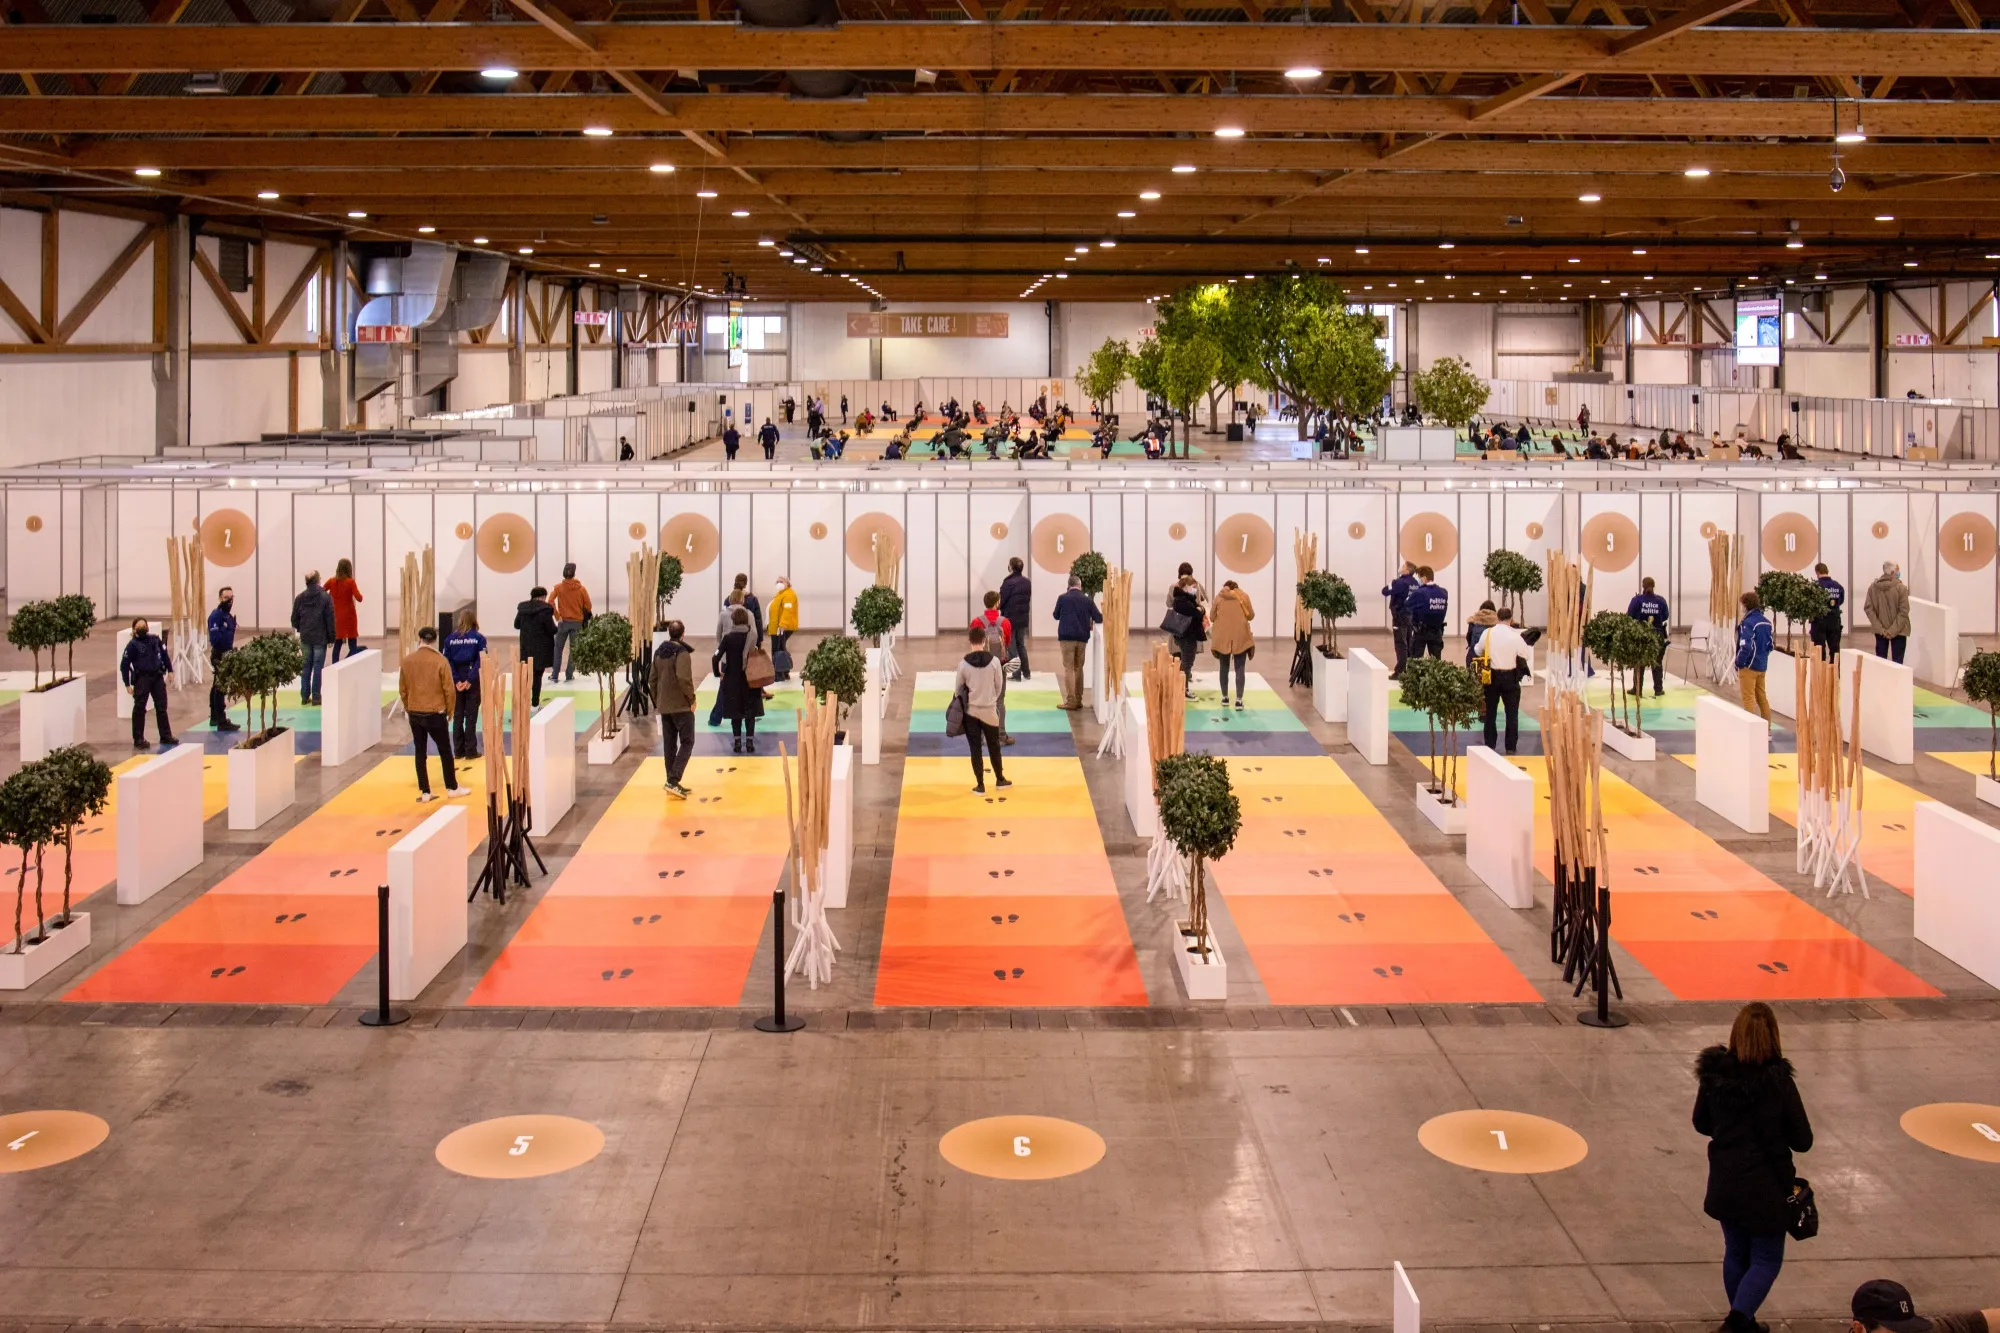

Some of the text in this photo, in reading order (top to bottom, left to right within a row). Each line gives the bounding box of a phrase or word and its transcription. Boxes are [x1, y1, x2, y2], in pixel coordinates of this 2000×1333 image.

[900, 316, 923, 333] TAKE
[225, 528, 231, 548] 2
[502, 534, 510, 553] 3
[685, 534, 693, 553] 4
[1057, 534, 1064, 553] 6
[1241, 534, 1248, 553] 7
[1425, 532, 1433, 552] 8
[1606, 532, 1614, 552] 9
[1784, 532, 1796, 552] 10
[1963, 532, 1974, 551] 11
[449, 638, 463, 647] Police
[7, 1130, 39, 1151] 4
[509, 1135, 534, 1156] 5
[1013, 1136, 1031, 1157] 6
